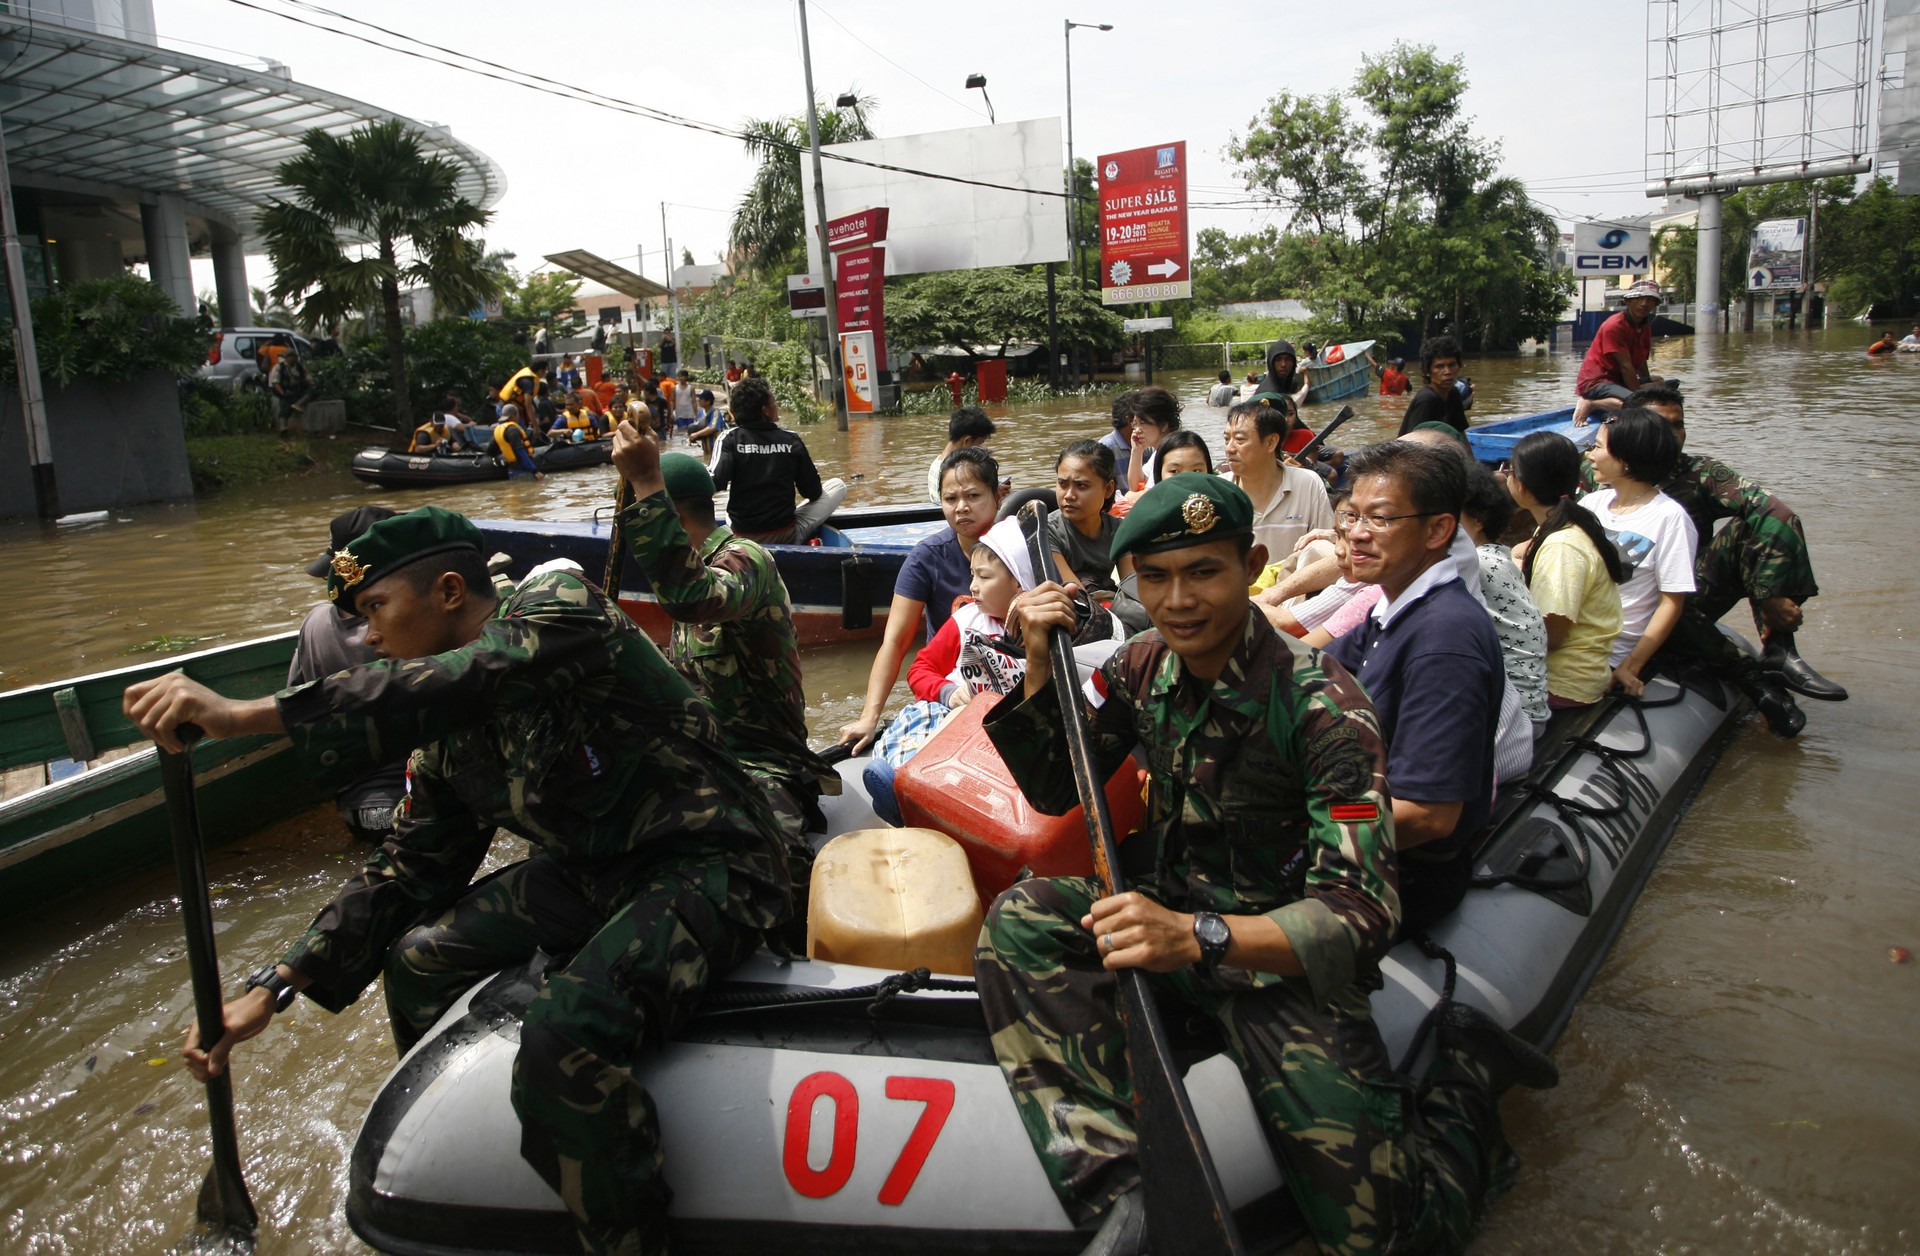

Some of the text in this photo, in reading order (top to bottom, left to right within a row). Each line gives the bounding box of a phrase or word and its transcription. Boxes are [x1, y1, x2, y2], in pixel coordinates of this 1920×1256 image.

[1154, 167, 1178, 176] REGATTA
[1105, 189, 1177, 211] SUPER SALE
[1118, 211, 1132, 219] NEW
[1133, 209, 1149, 217] YEAR
[1150, 205, 1178, 214] BAZAAR
[828, 217, 867, 237] avehotel
[1132, 223, 1146, 231] Jan
[1147, 220, 1171, 228] REGATTA
[1147, 226, 1169, 235] LOUNGE
[1106, 225, 1132, 241] 19-20
[1132, 230, 1147, 238] 2013
[1577, 255, 1648, 269] CBM
[1111, 284, 1178, 300] 666 030 80
[856, 364, 866, 379] P
[736, 443, 793, 454] GERMANY
[986, 650, 1005, 680] Going
[782, 1071, 956, 1206] 07
